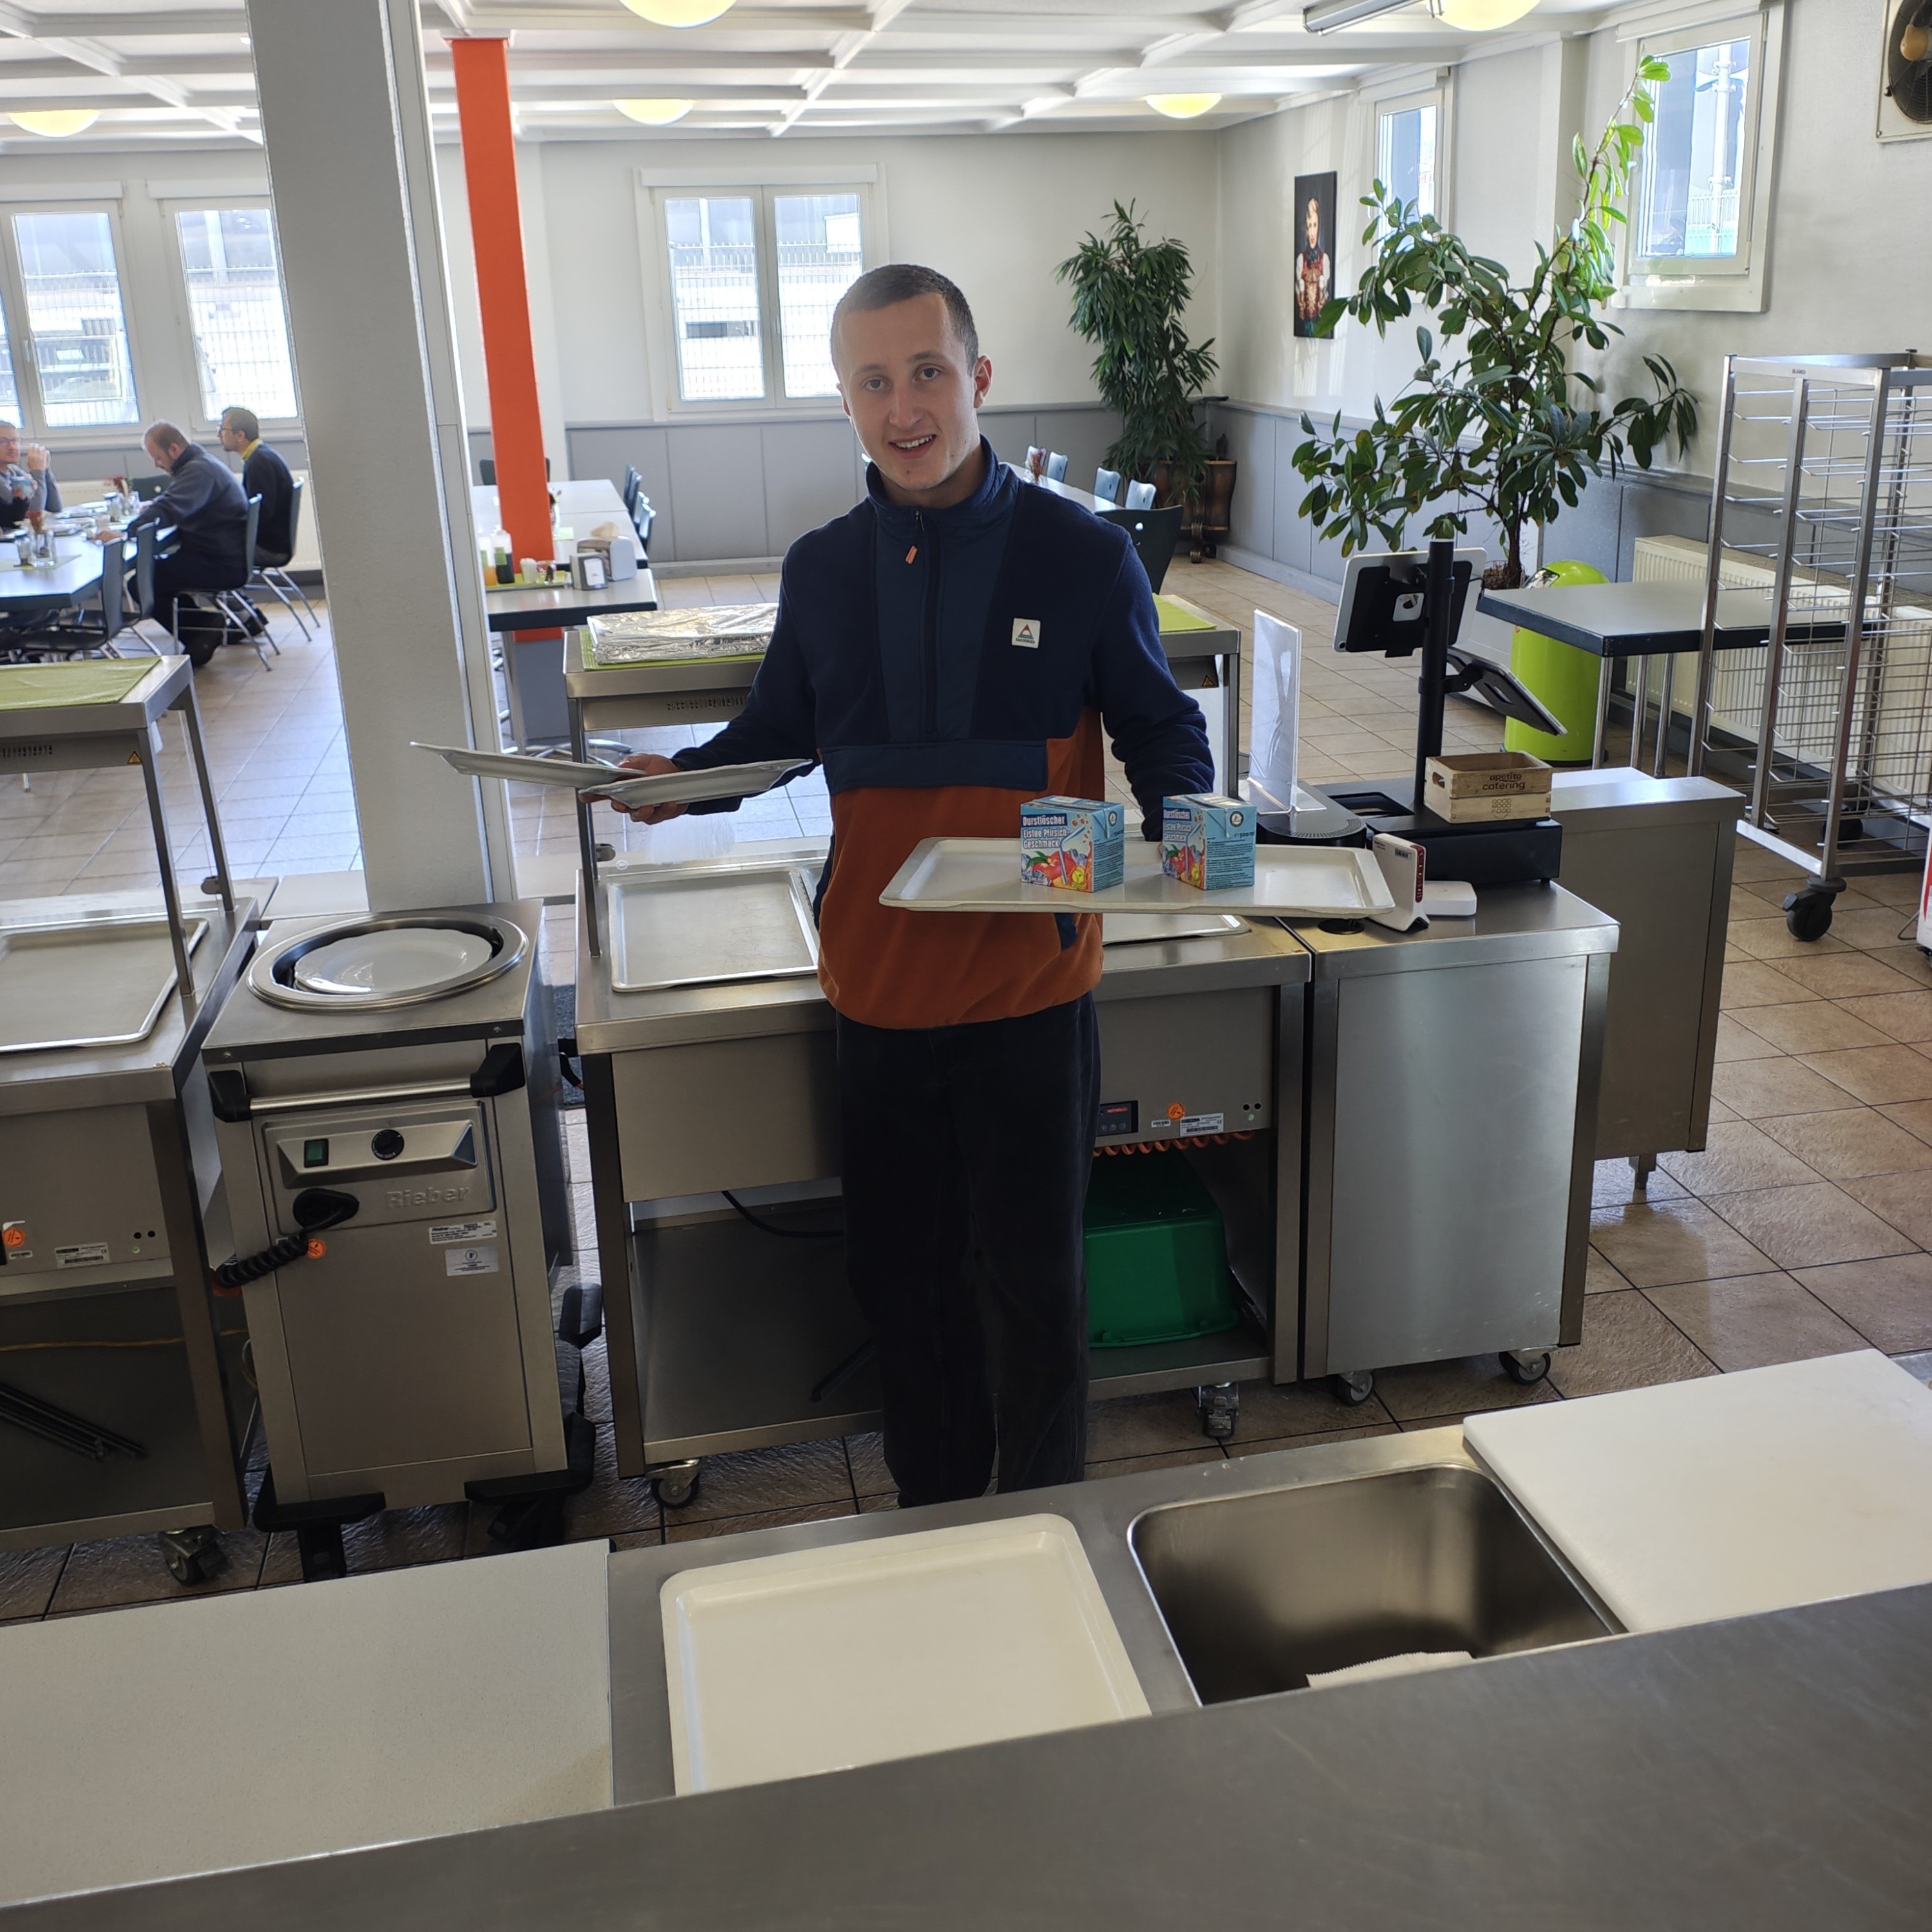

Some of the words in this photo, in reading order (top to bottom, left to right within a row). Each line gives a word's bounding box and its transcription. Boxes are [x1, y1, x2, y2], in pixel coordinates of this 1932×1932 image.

[1490, 772, 1522, 781] apetito
[1482, 782, 1525, 790] catering
[1023, 815, 1065, 826] Durstlöscher
[1023, 829, 1042, 838] Eistee
[1023, 839, 1059, 848] Geschmack
[386, 1187, 469, 1208] Rieber
